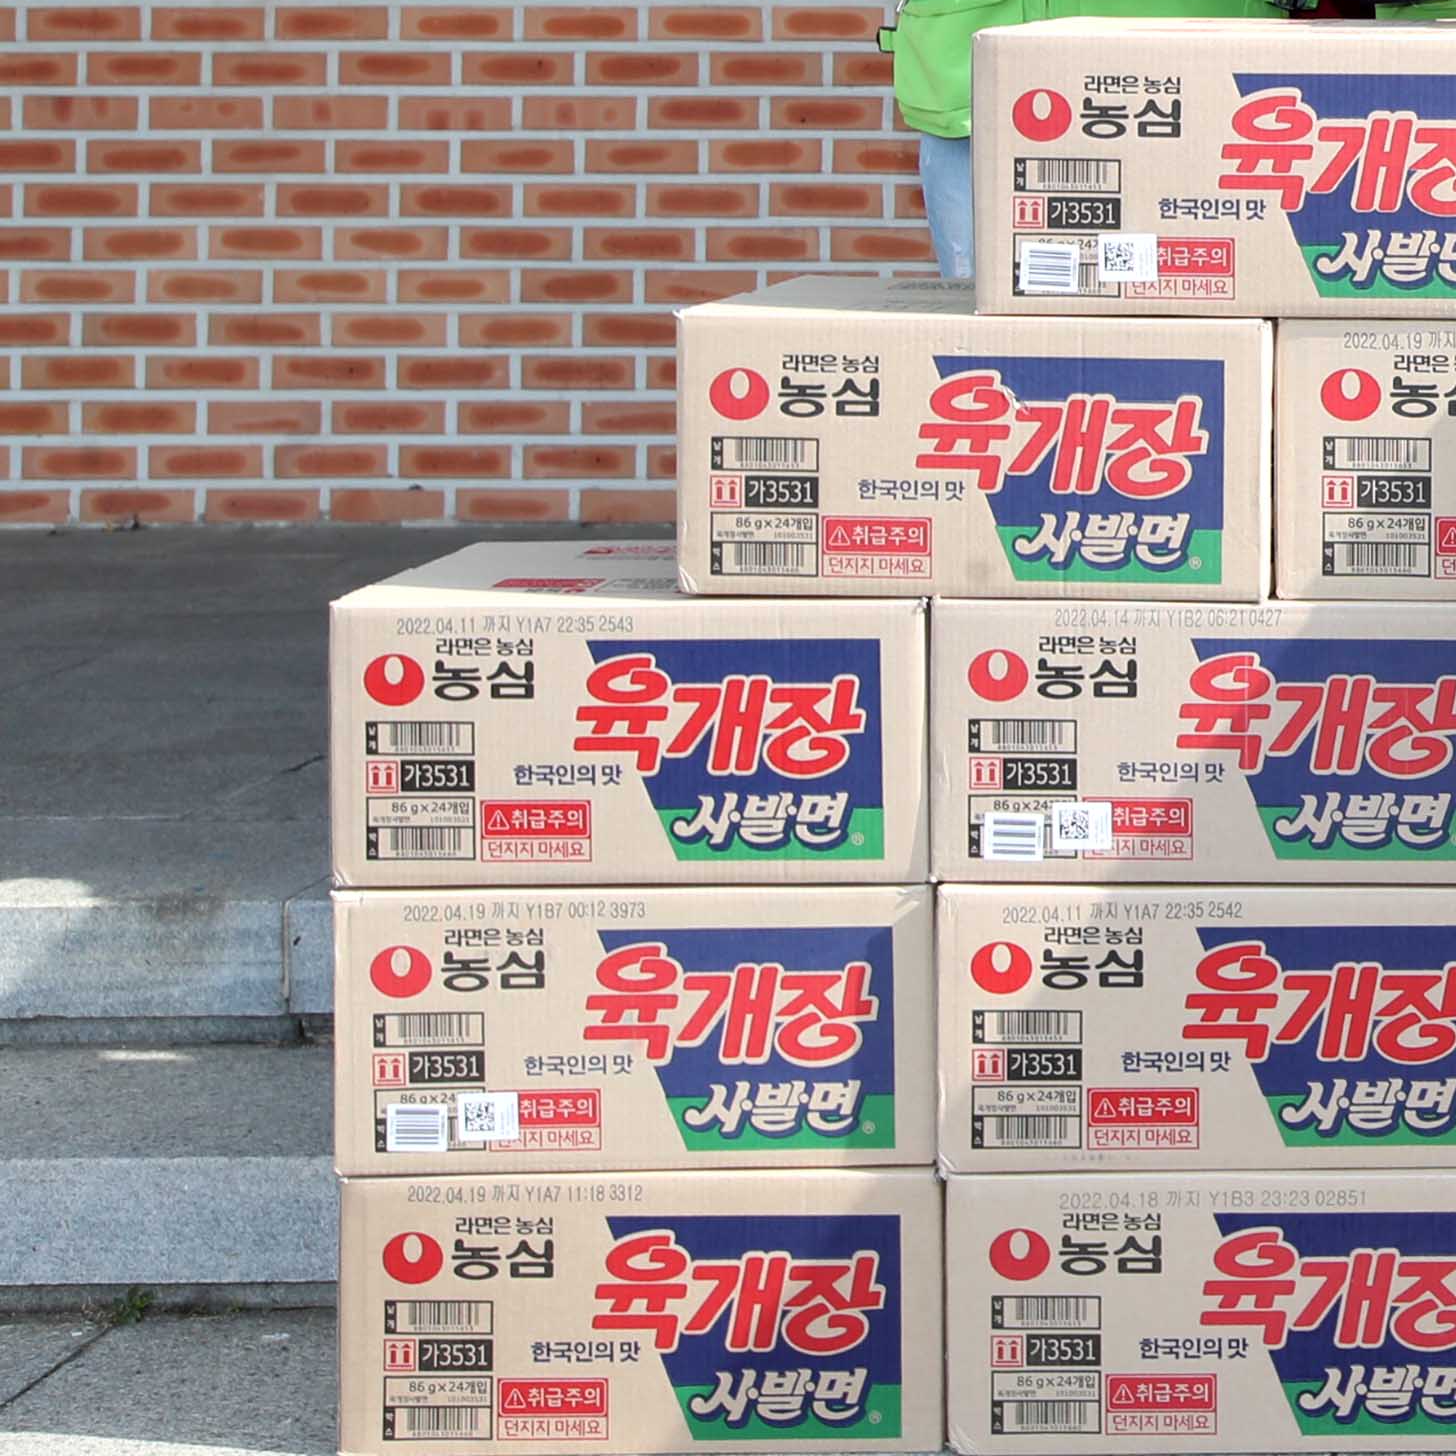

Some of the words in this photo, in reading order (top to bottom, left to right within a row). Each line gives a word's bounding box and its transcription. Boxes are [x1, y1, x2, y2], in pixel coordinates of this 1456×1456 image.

[1079, 98, 1182, 138] 농심
[777, 377, 880, 418] 농심
[916, 373, 1206, 496] 육개장
[1361, 480, 1426, 505] 가3531
[1013, 512, 1190, 566] 사발면
[397, 618, 474, 637] 2022.04.11
[556, 616, 594, 633] 22:35
[432, 661, 535, 701] 농심
[1035, 659, 1138, 699] 농심
[572, 654, 864, 776] 육개장
[673, 793, 850, 846] 사발면
[1275, 793, 1452, 845] 사발면
[440, 951, 545, 992] 농심
[1040, 949, 1144, 990] 농심
[582, 941, 876, 1065] 육개장
[683, 1080, 862, 1134] 사발면
[451, 1239, 555, 1280] 농심
[1058, 1235, 1162, 1276] 농심
[591, 1231, 883, 1354] 육개장
[690, 1370, 868, 1423] 사발면
